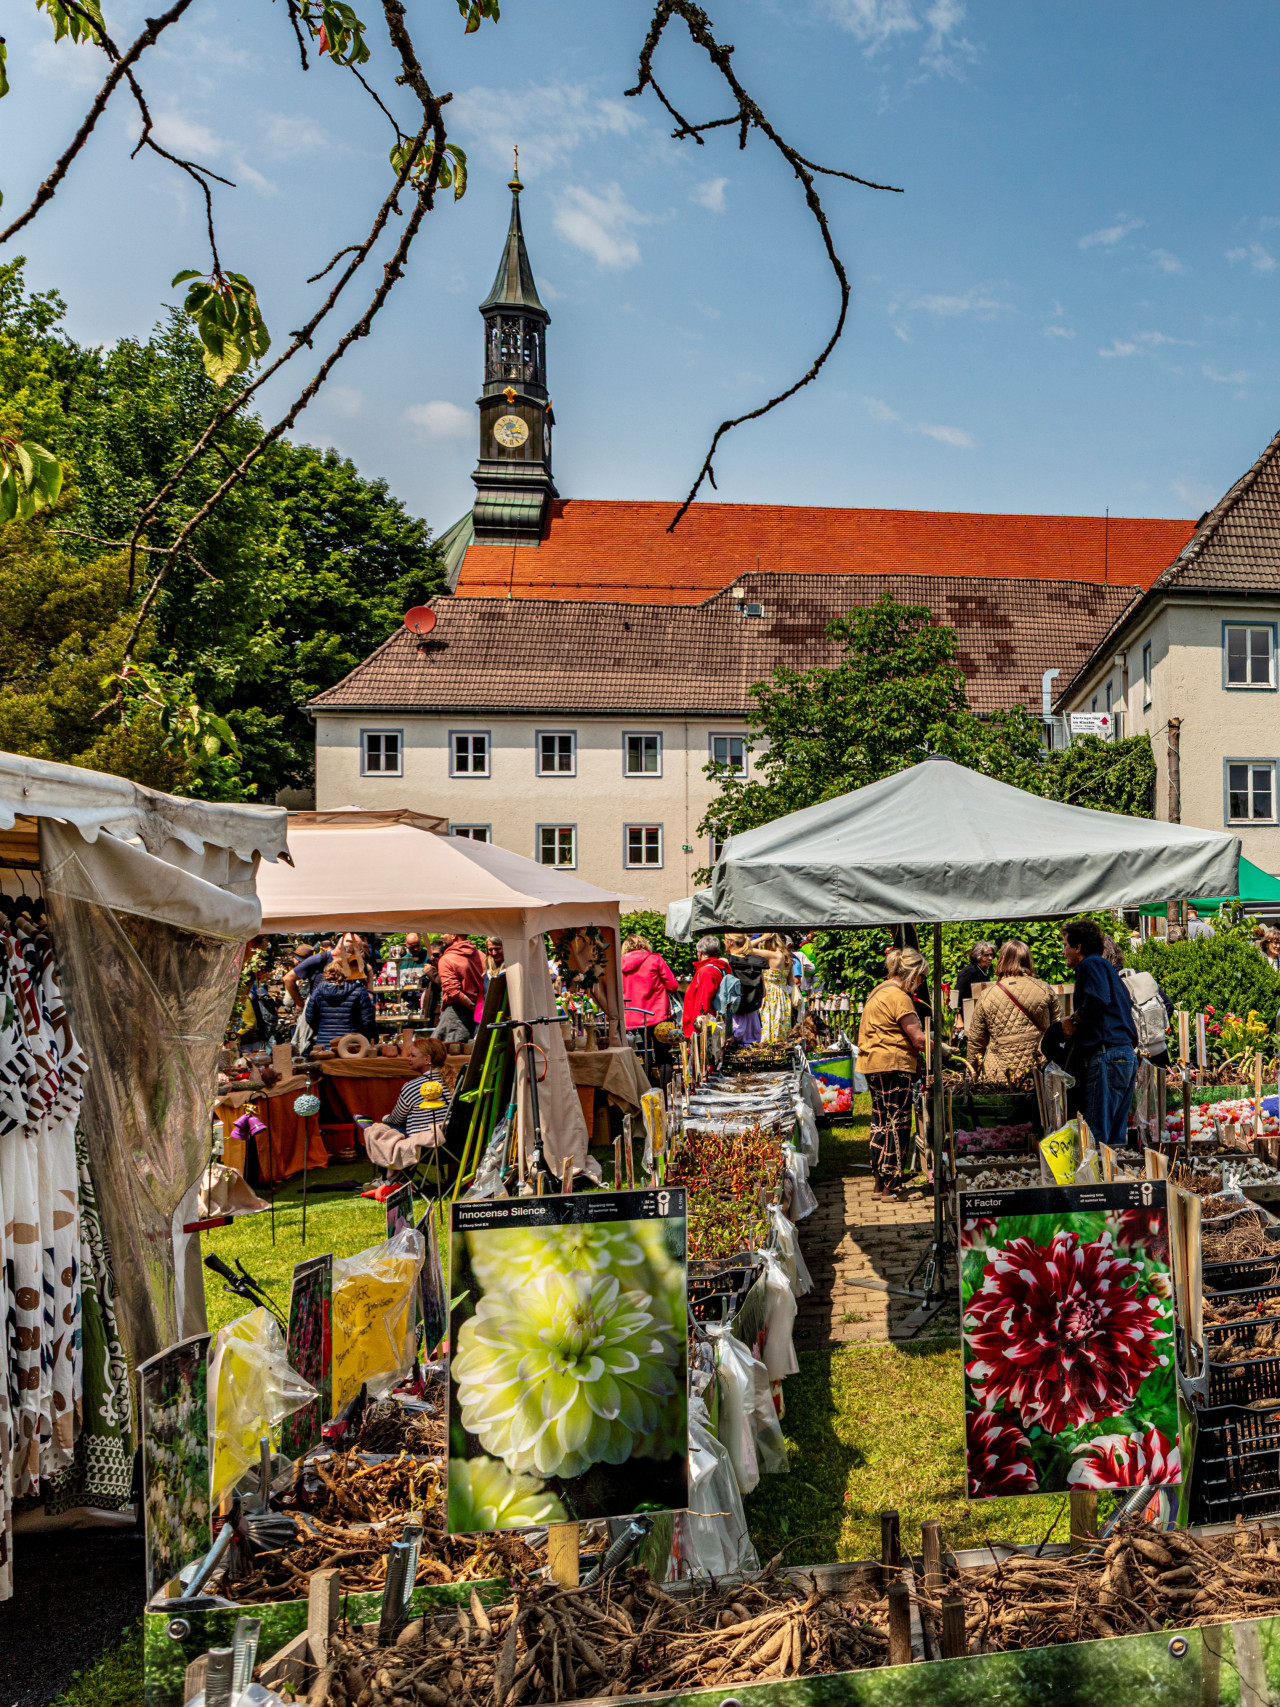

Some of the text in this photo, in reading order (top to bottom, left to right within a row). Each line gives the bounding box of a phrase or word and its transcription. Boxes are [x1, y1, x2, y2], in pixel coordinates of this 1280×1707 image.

[965, 1198, 1002, 1208] X Factor
[459, 1207, 546, 1220] Innocense Silence
